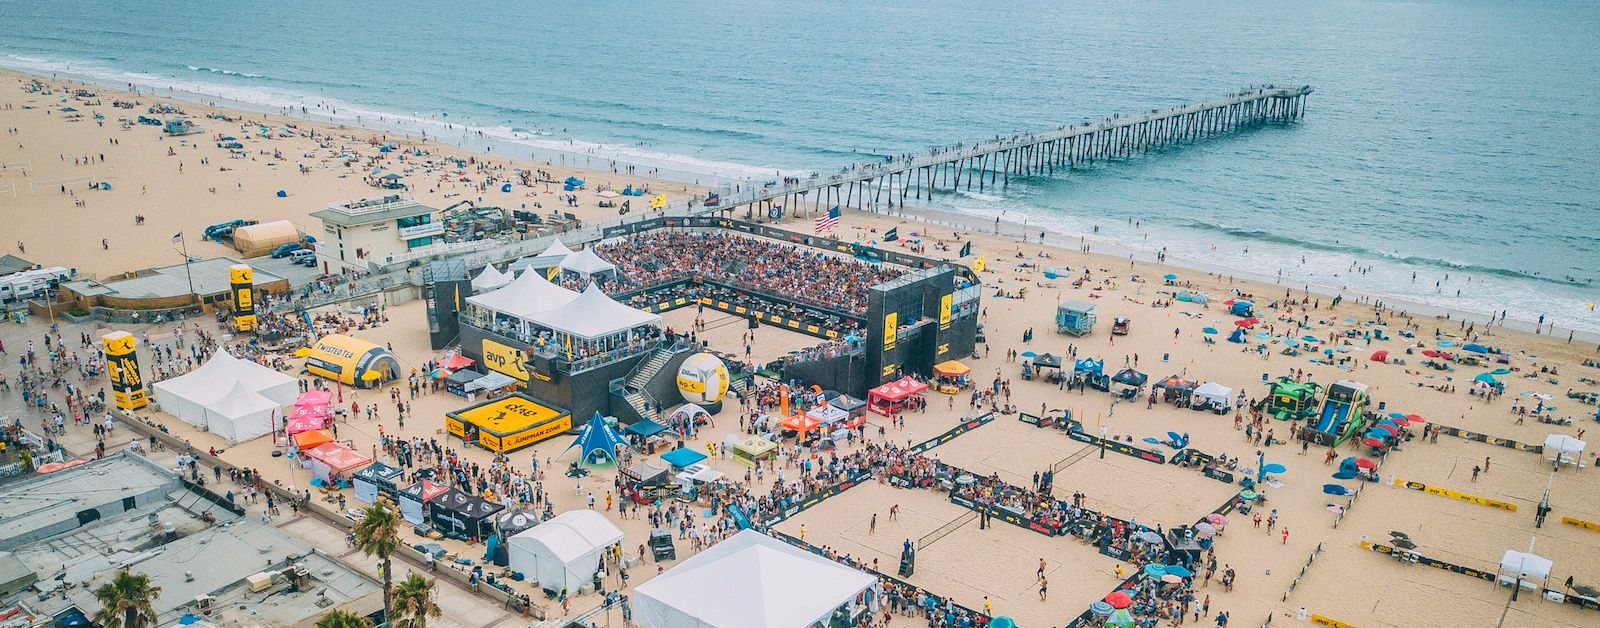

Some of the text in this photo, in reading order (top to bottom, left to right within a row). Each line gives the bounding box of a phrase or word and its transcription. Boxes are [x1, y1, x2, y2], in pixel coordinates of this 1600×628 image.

[318, 343, 354, 359] TWISTED TEA
[487, 350, 506, 367] avp
[681, 368, 698, 378] Wilson
[506, 404, 537, 417] avp
[514, 425, 561, 444] JUMPMAN ZONE
[1030, 522, 1050, 534] Wilson
